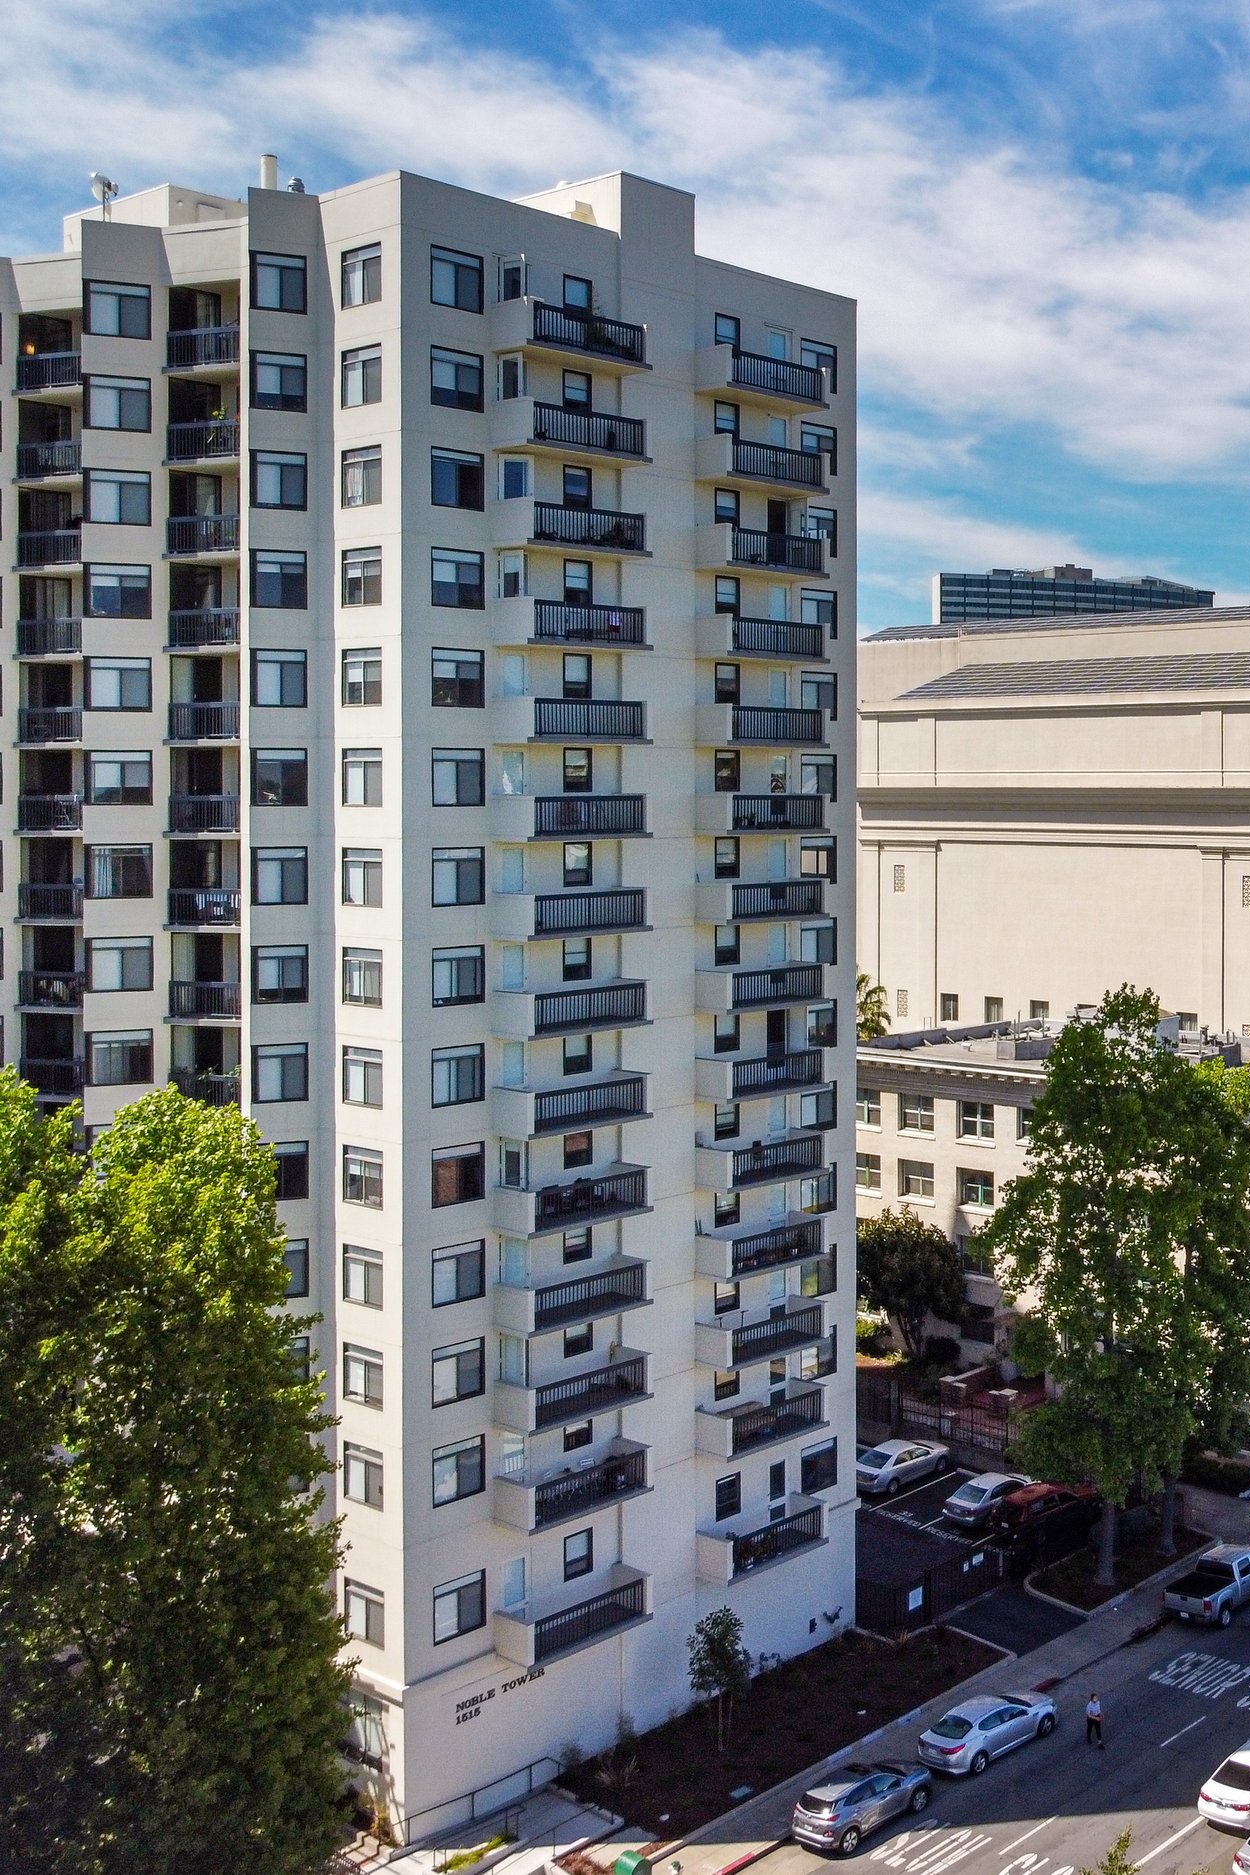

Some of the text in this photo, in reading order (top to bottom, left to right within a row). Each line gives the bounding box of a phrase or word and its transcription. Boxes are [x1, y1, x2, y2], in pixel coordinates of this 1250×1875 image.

[925, 1526, 973, 1545] RESERVED
[455, 1667, 545, 1713] NOBLE TOWER
[455, 1706, 481, 1726] 1515
